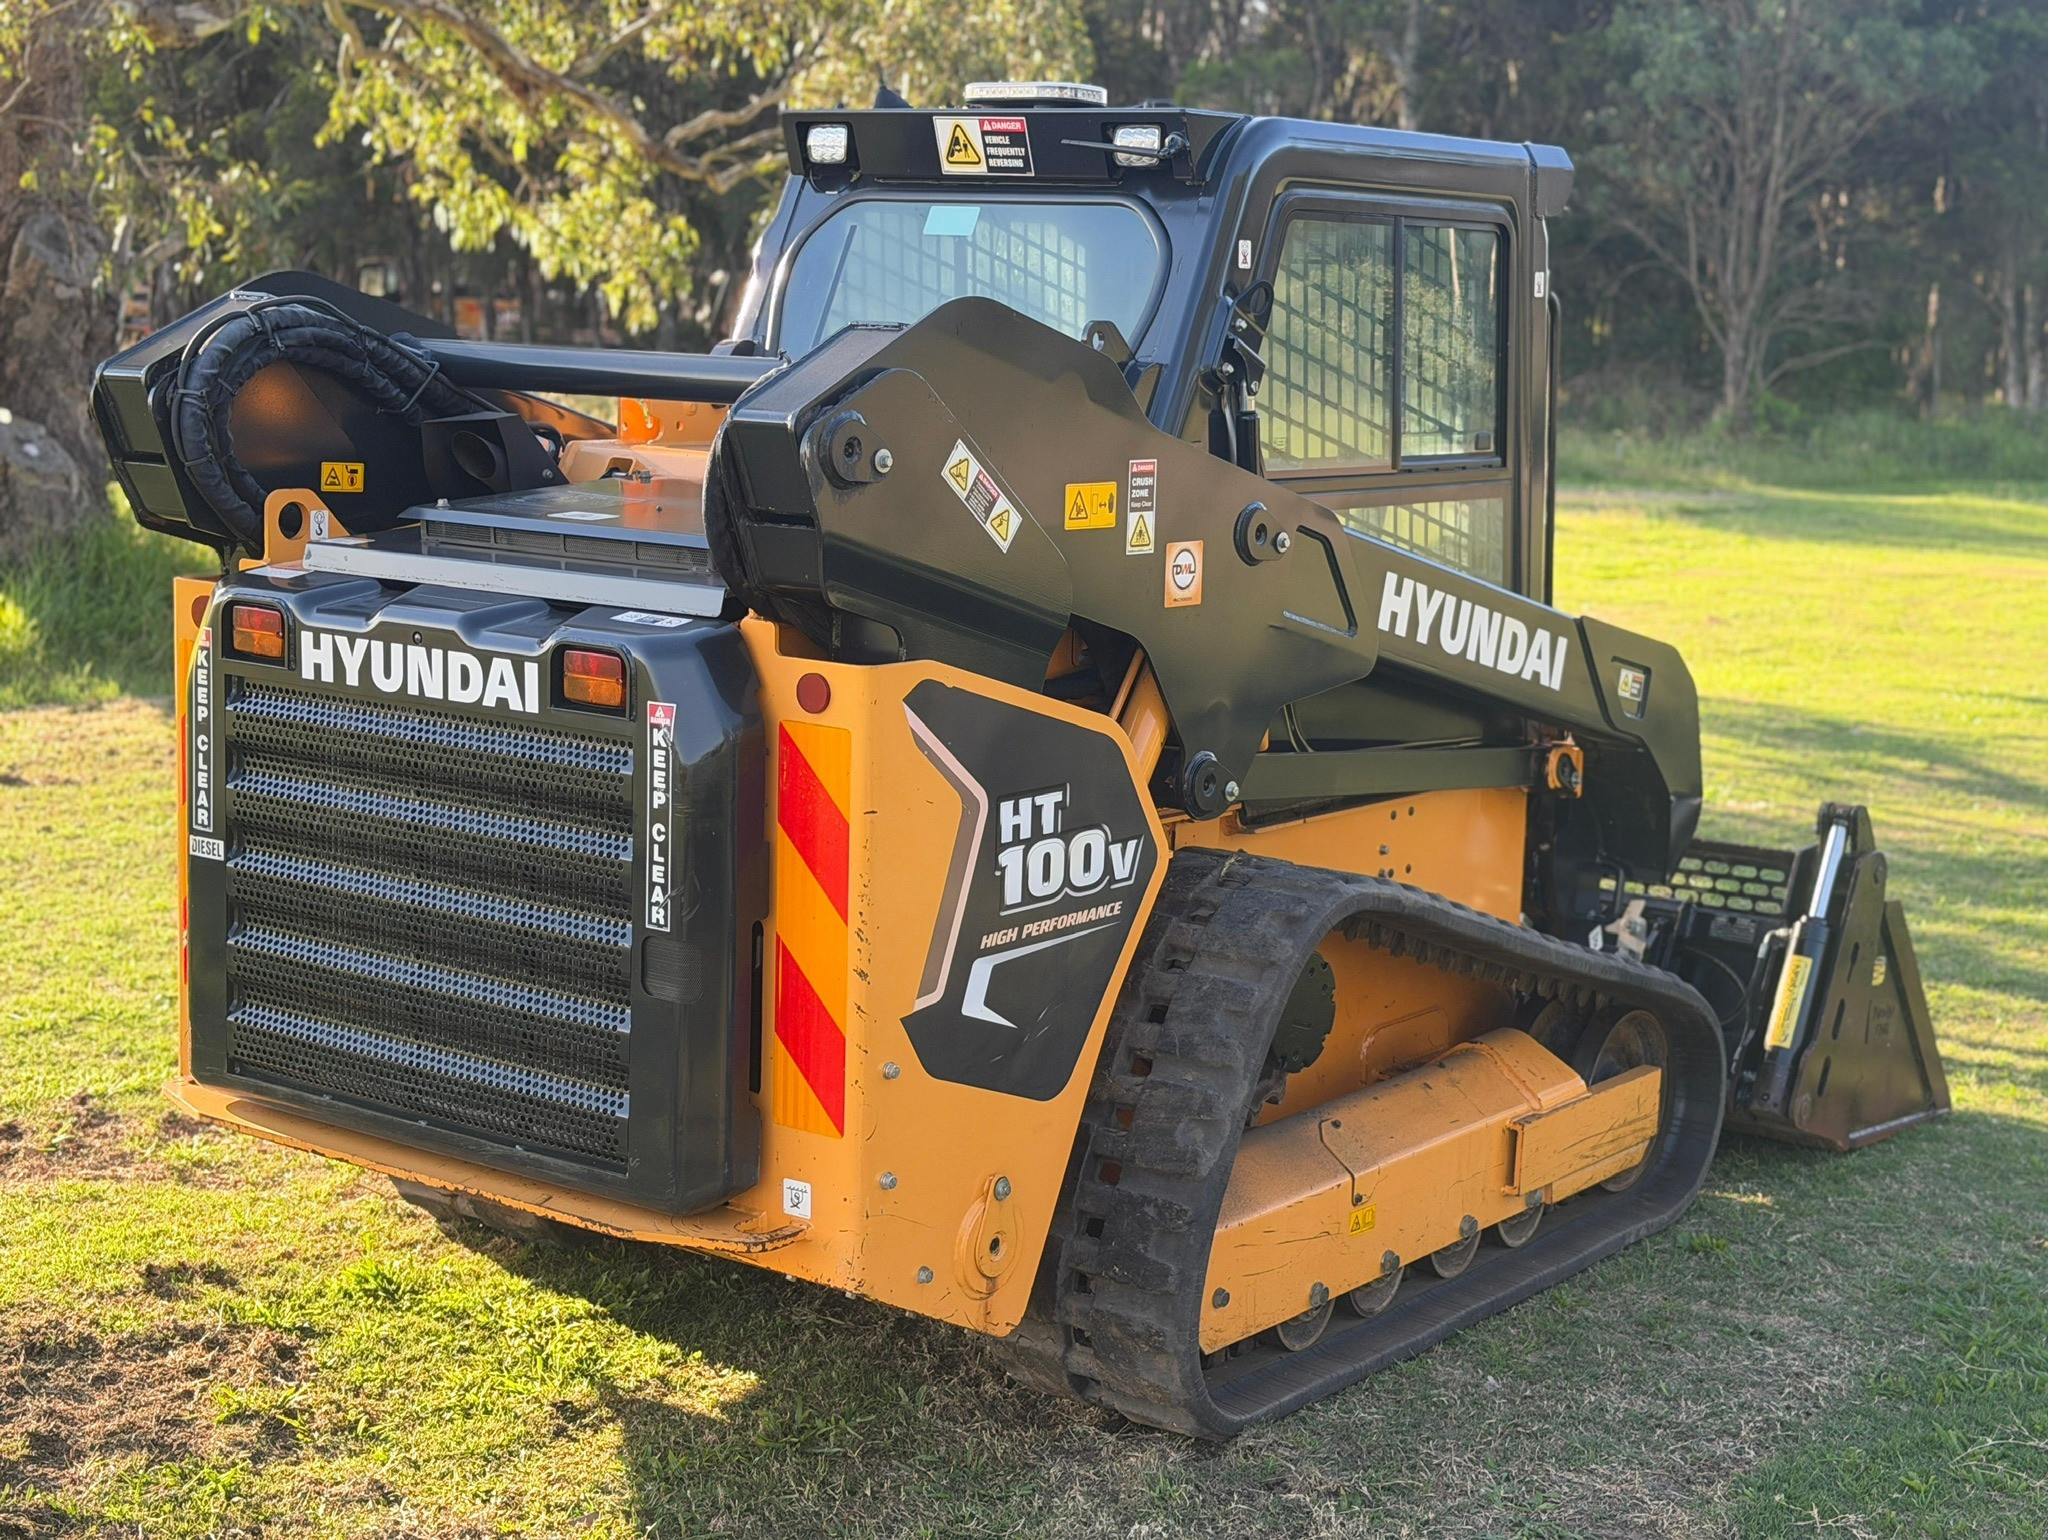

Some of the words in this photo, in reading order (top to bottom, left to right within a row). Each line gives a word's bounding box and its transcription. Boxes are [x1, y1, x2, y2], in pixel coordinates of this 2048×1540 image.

[984, 135, 1010, 145] VEHICLE
[991, 121, 1022, 130] DANGER
[986, 147, 1026, 157] FREQUENTLY
[988, 158, 1024, 168] REVERSING
[1131, 476, 1154, 487] CRUSH
[1131, 489, 1150, 498] ZONE
[1131, 501, 1141, 509] Keep
[1377, 571, 1568, 691] HYUNDAI
[197, 649, 209, 722] KEEP
[300, 630, 539, 714] HYUNDAI
[197, 734, 209, 826] CLEAR
[652, 727, 668, 810] KEEP
[1000, 791, 1064, 844] HT
[191, 837, 222, 858] DIESEL
[651, 822, 667, 926] CLEAR
[980, 926, 1019, 950] HIGH
[1021, 901, 1124, 939] PERFORMANCE
